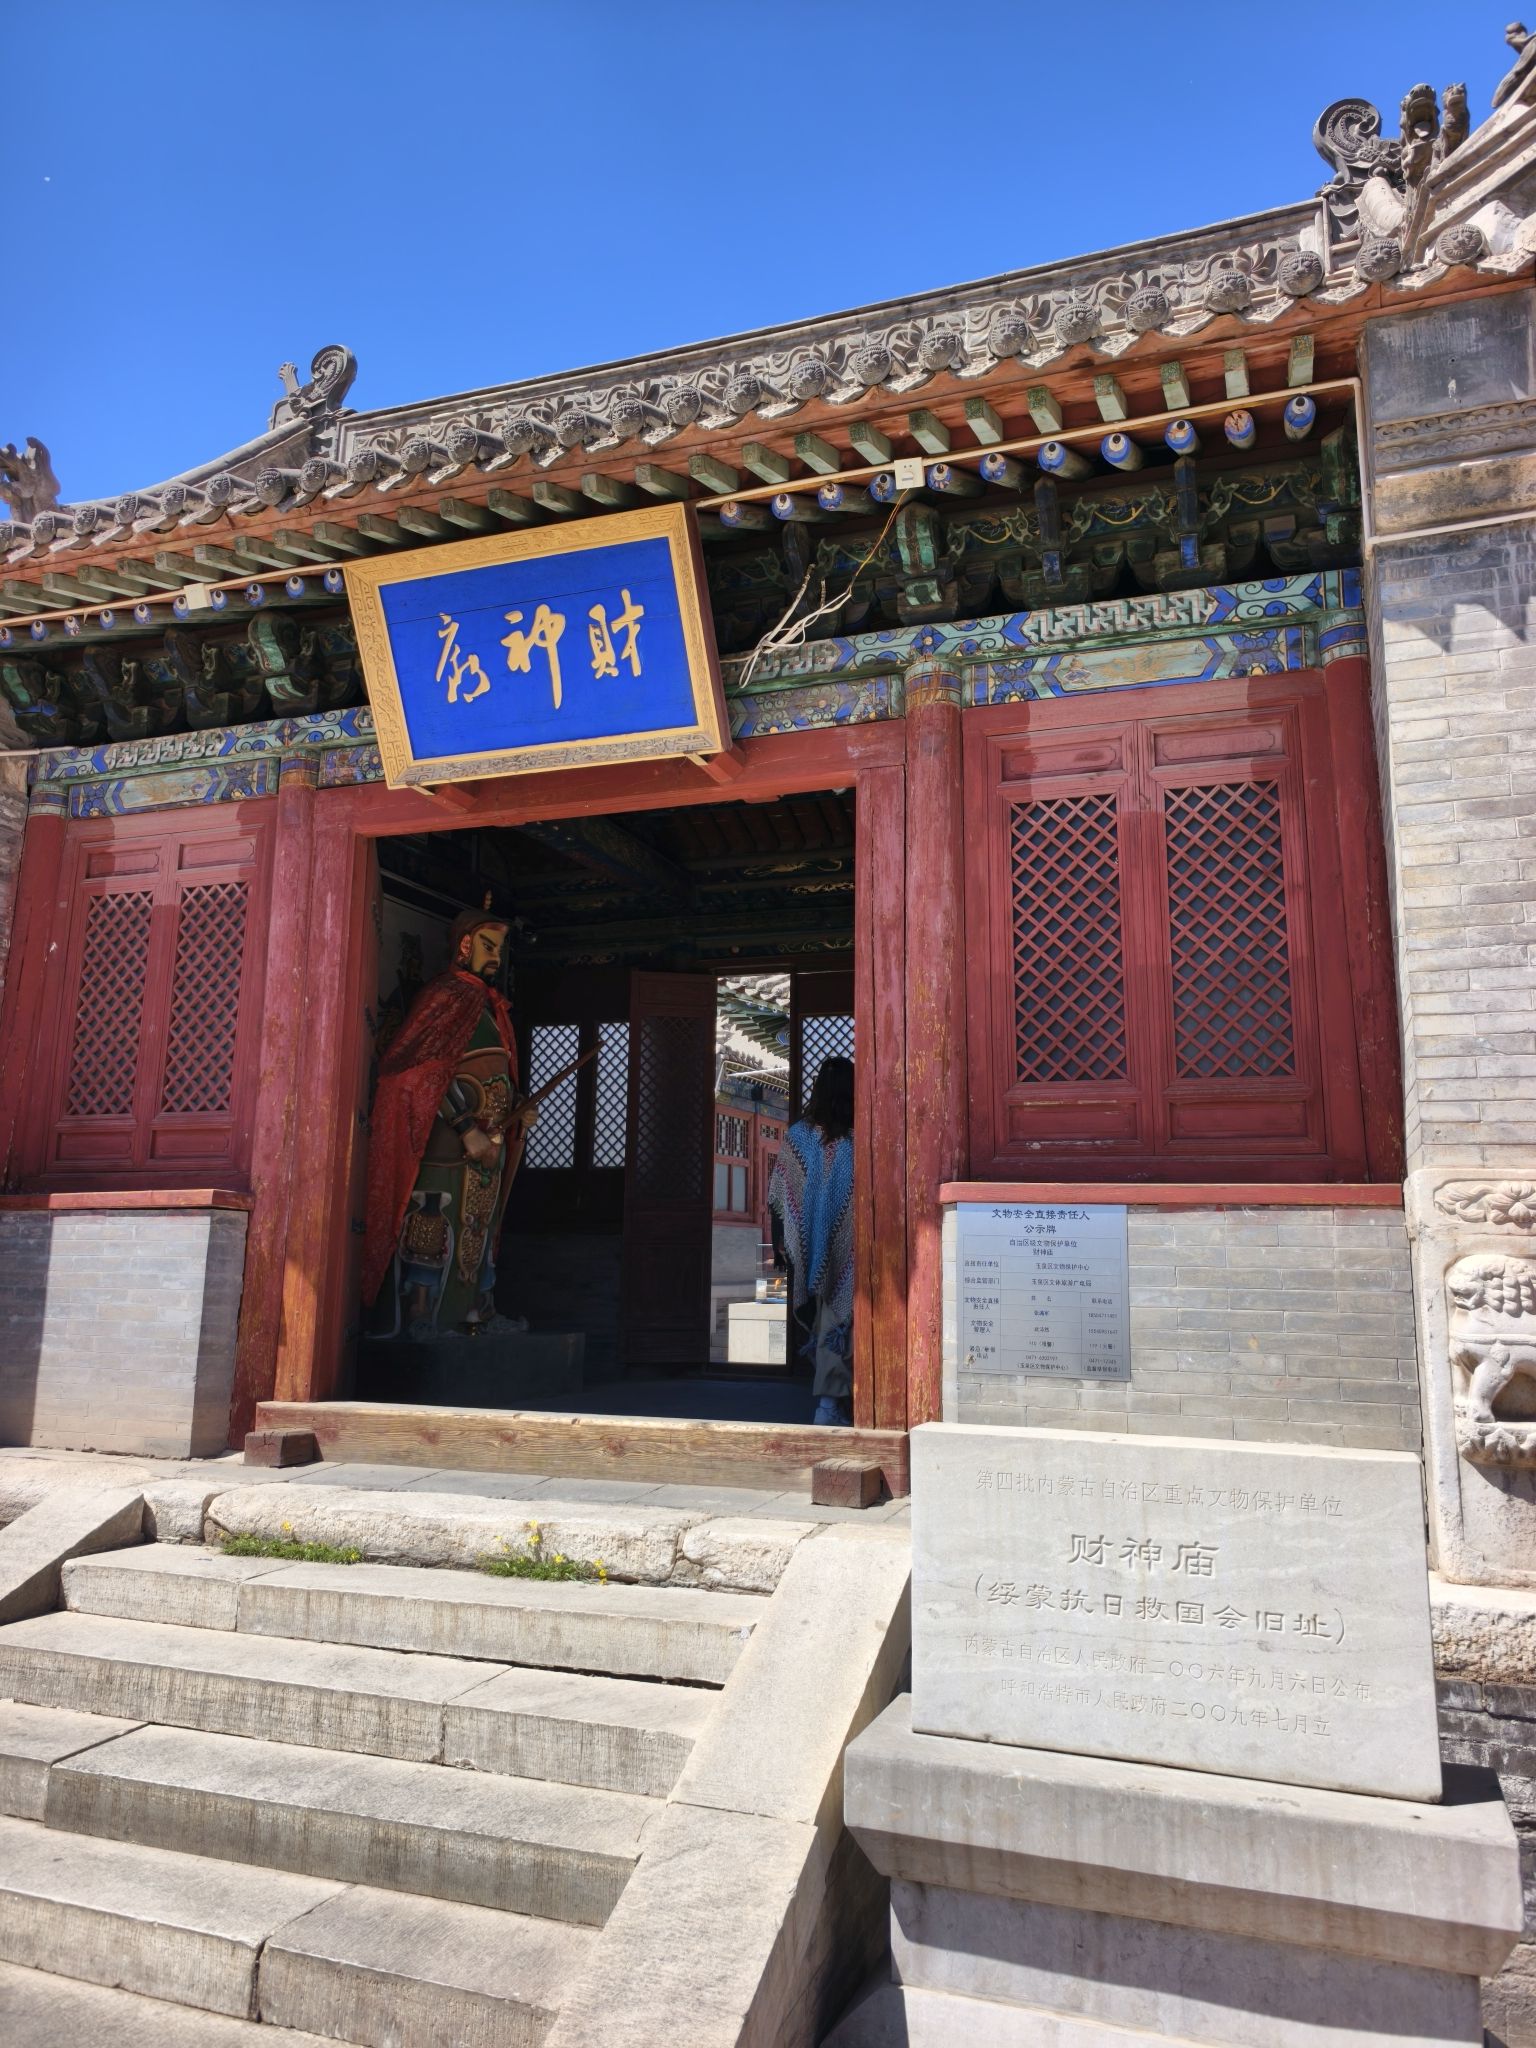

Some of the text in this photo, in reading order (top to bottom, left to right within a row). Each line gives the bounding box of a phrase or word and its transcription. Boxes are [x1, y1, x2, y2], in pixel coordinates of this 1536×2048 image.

[991, 1208, 1091, 1221] 文物安全直接责任人
[1023, 1224, 1057, 1234] 公示牌
[1009, 1238, 1078, 1248] 自治区级文物保护单位
[976, 1469, 1343, 1517] 第四批内蒙古自治区重点文物保护单位
[1066, 1533, 1220, 1579] 财神庙
